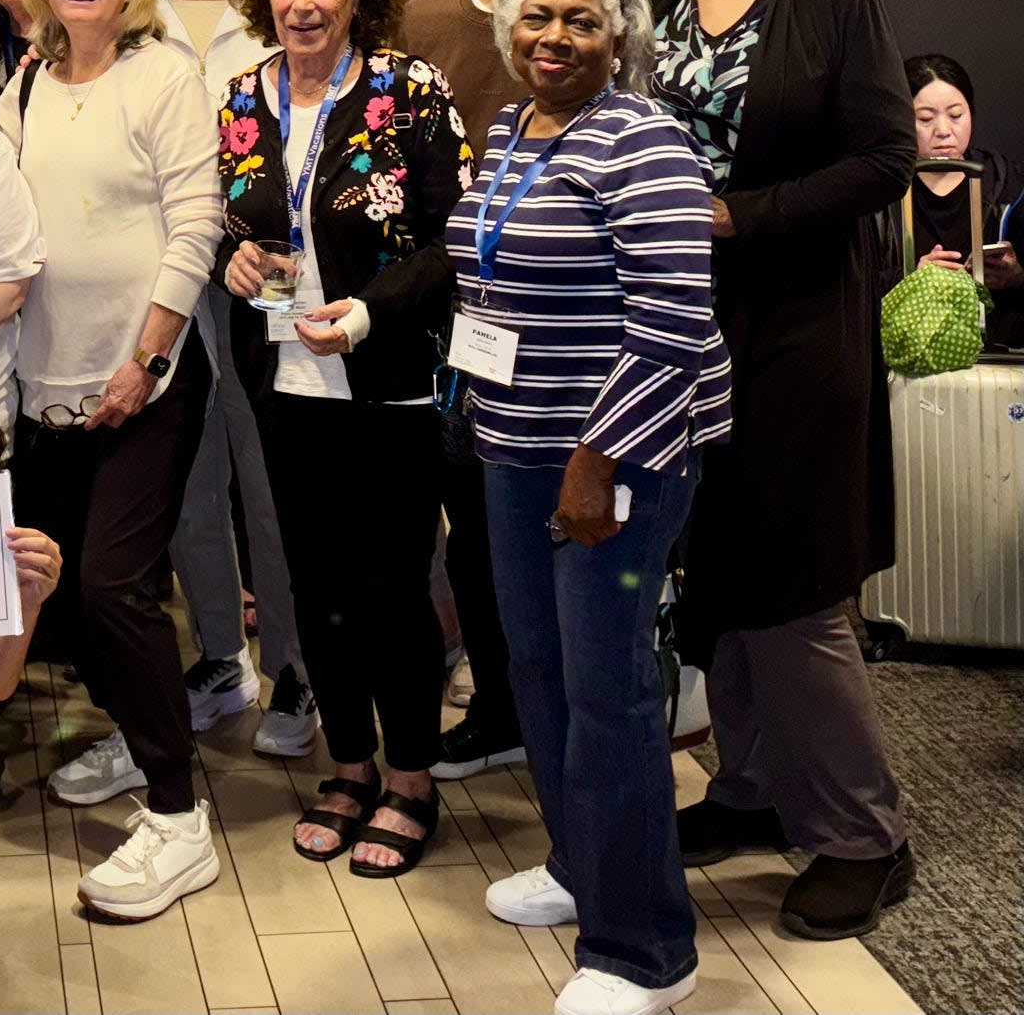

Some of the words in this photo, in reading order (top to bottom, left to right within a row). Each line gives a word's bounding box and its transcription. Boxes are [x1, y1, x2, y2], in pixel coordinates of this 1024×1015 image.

[302, 156, 314, 176] YMT
[308, 113, 328, 156] Vacations
[472, 329, 497, 341] PAMELA
